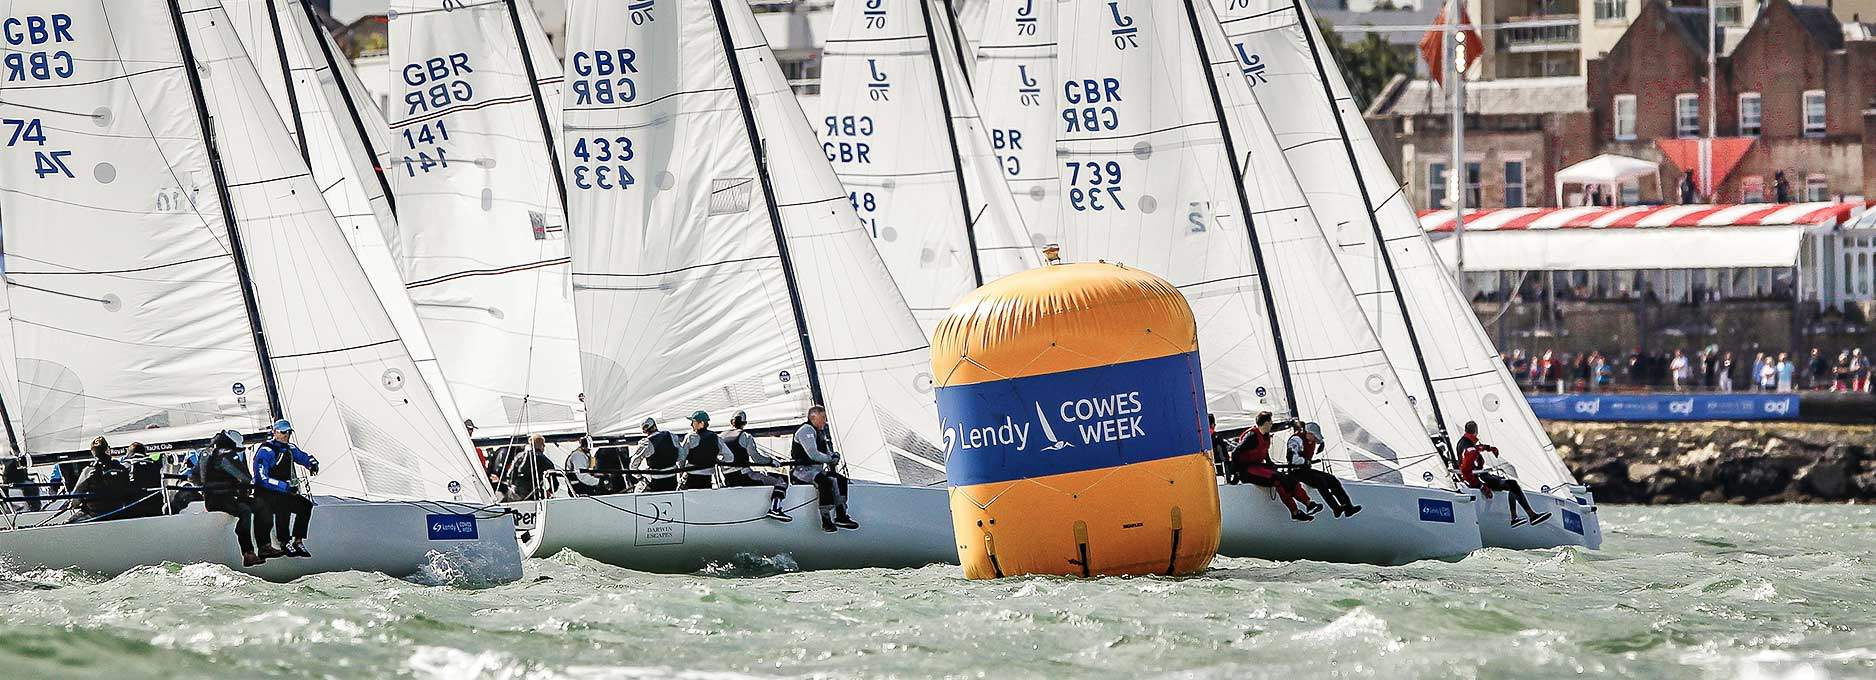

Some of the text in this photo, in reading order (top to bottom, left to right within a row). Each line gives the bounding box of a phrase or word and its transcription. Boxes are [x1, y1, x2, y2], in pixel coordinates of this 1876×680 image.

[3, 14, 74, 45] GBR
[866, 16, 886, 29] 70
[1017, 23, 1036, 36] 70
[402, 52, 473, 87] GBR
[573, 48, 639, 77] GBR
[1064, 77, 1122, 104] GBR
[2, 118, 47, 147] 74
[402, 119, 449, 150] 141
[992, 129, 1022, 150] BR
[573, 137, 634, 162] 433
[823, 142, 871, 163] GBR
[1066, 161, 1122, 186] 739
[850, 191, 876, 212] 48
[1060, 391, 1142, 423] COWES
[958, 415, 1030, 451] Lendy
[1079, 415, 1146, 445] WEEK
